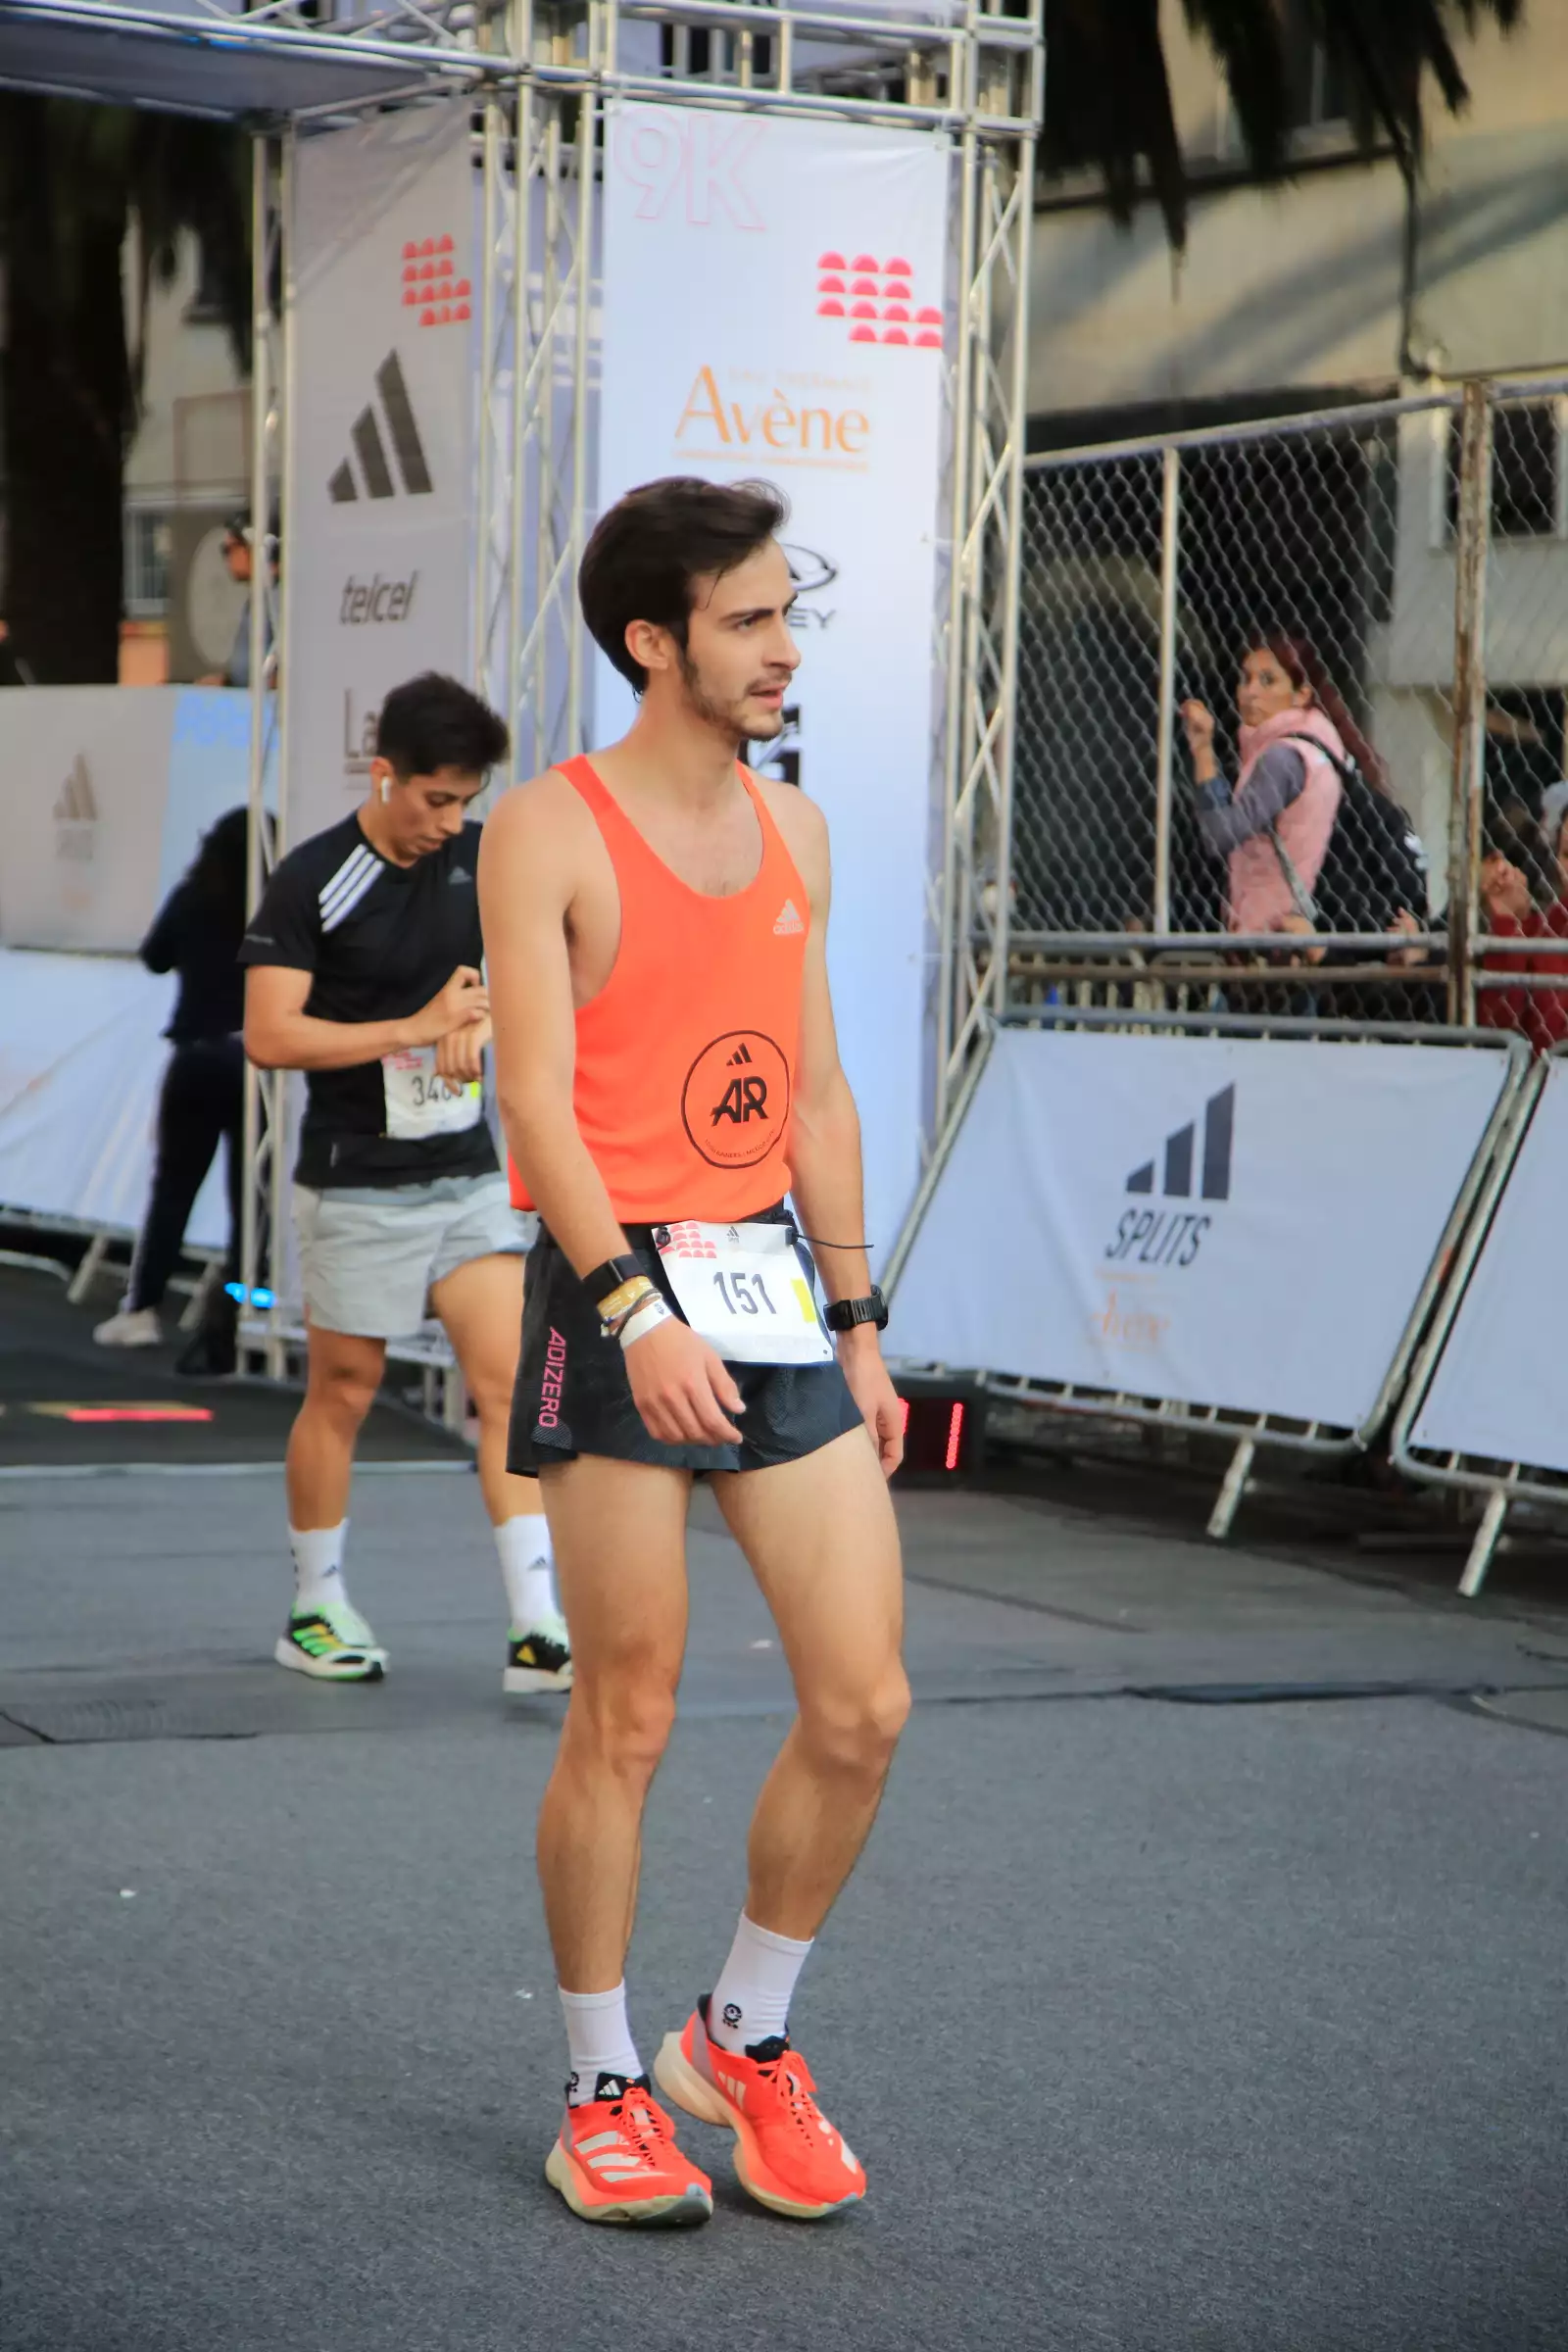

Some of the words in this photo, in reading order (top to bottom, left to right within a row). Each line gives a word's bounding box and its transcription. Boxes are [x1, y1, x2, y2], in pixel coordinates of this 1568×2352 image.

[613, 107, 771, 231] 9K
[674, 364, 870, 454] Avène
[338, 568, 420, 625] telcel
[710, 1076, 769, 1127] AR
[1104, 1205, 1212, 1267] SPLITS
[713, 1271, 777, 1315] 151
[538, 1326, 566, 1428] ADIZERO
